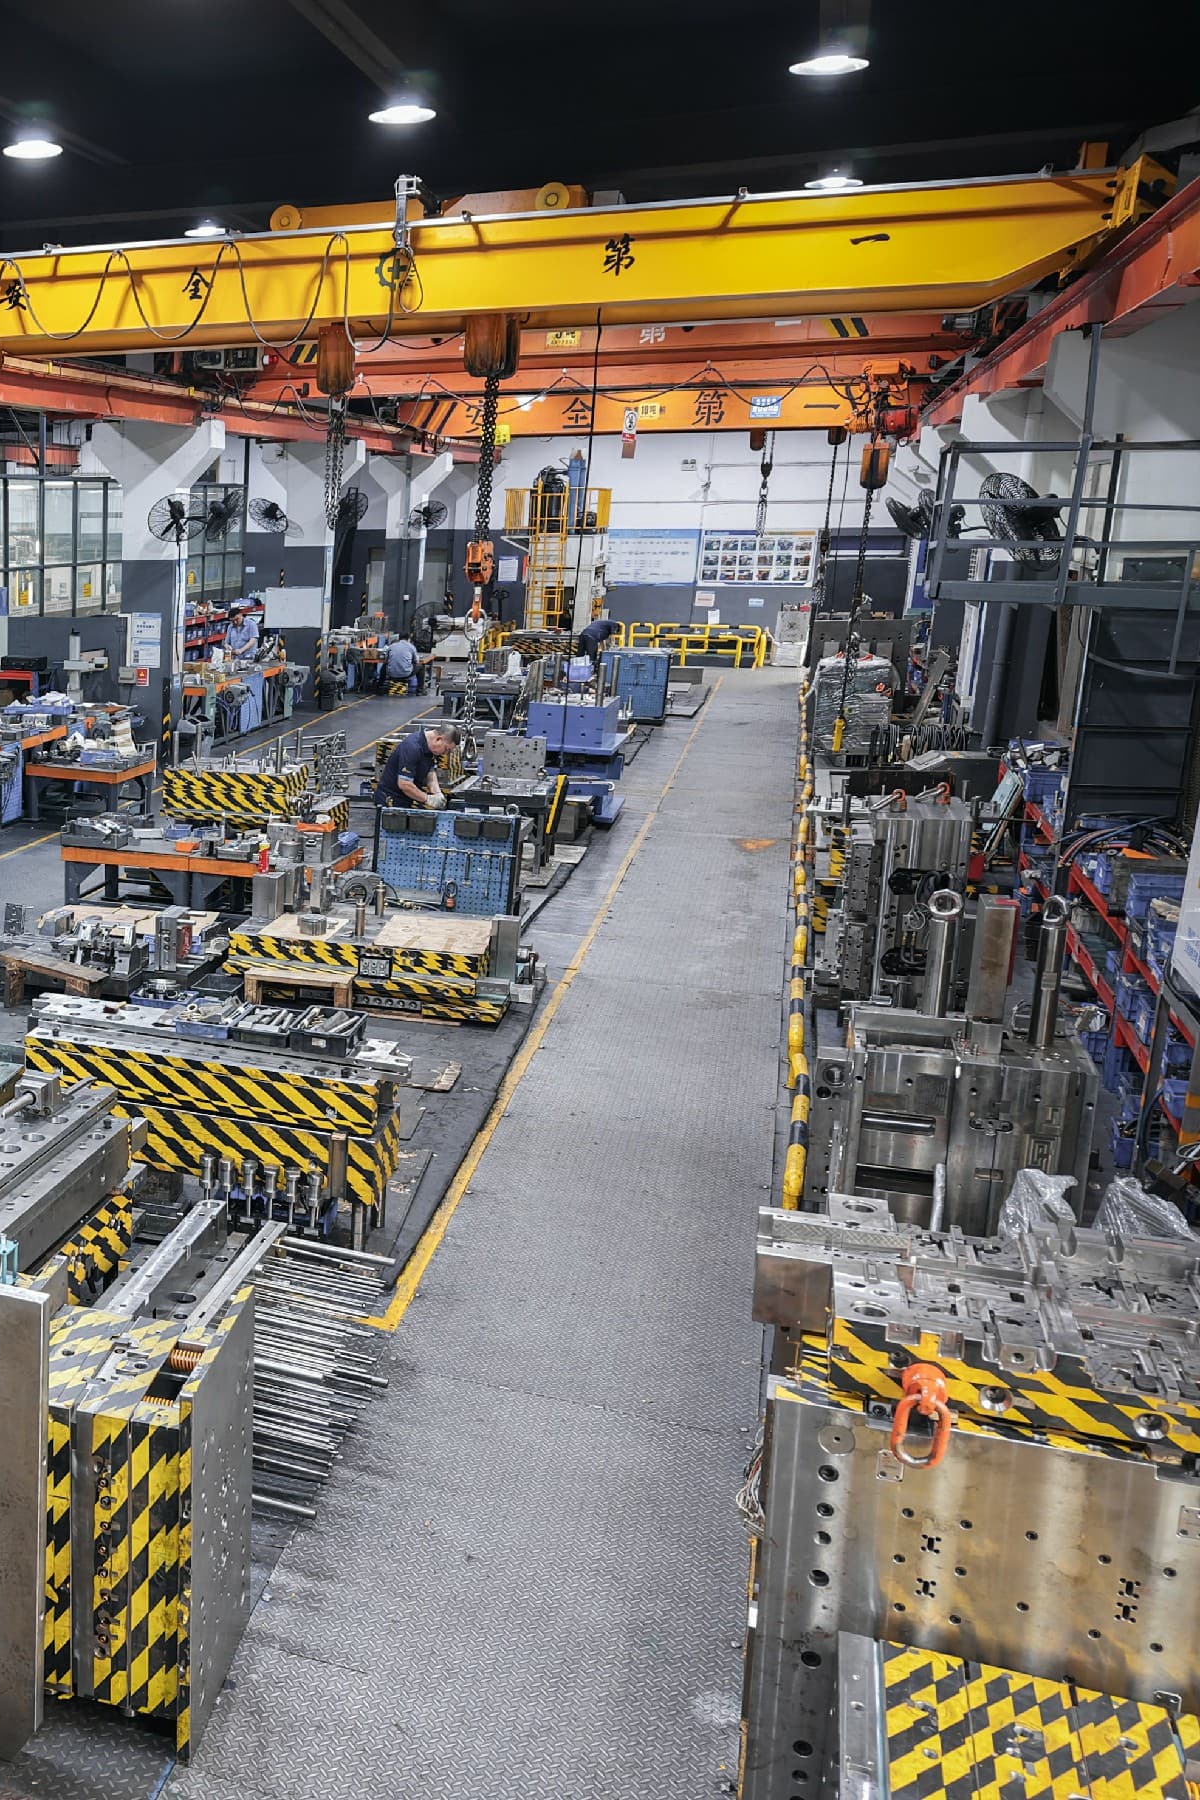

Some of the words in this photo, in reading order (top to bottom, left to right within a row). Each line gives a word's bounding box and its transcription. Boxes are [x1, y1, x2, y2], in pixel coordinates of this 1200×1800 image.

[0, 280, 29, 310] 安
[182, 267, 213, 300] 全
[602, 233, 636, 276] 第
[849, 233, 891, 245] 一
[561, 397, 593, 429] 全
[692, 390, 729, 426] 第
[803, 402, 842, 410] 一
